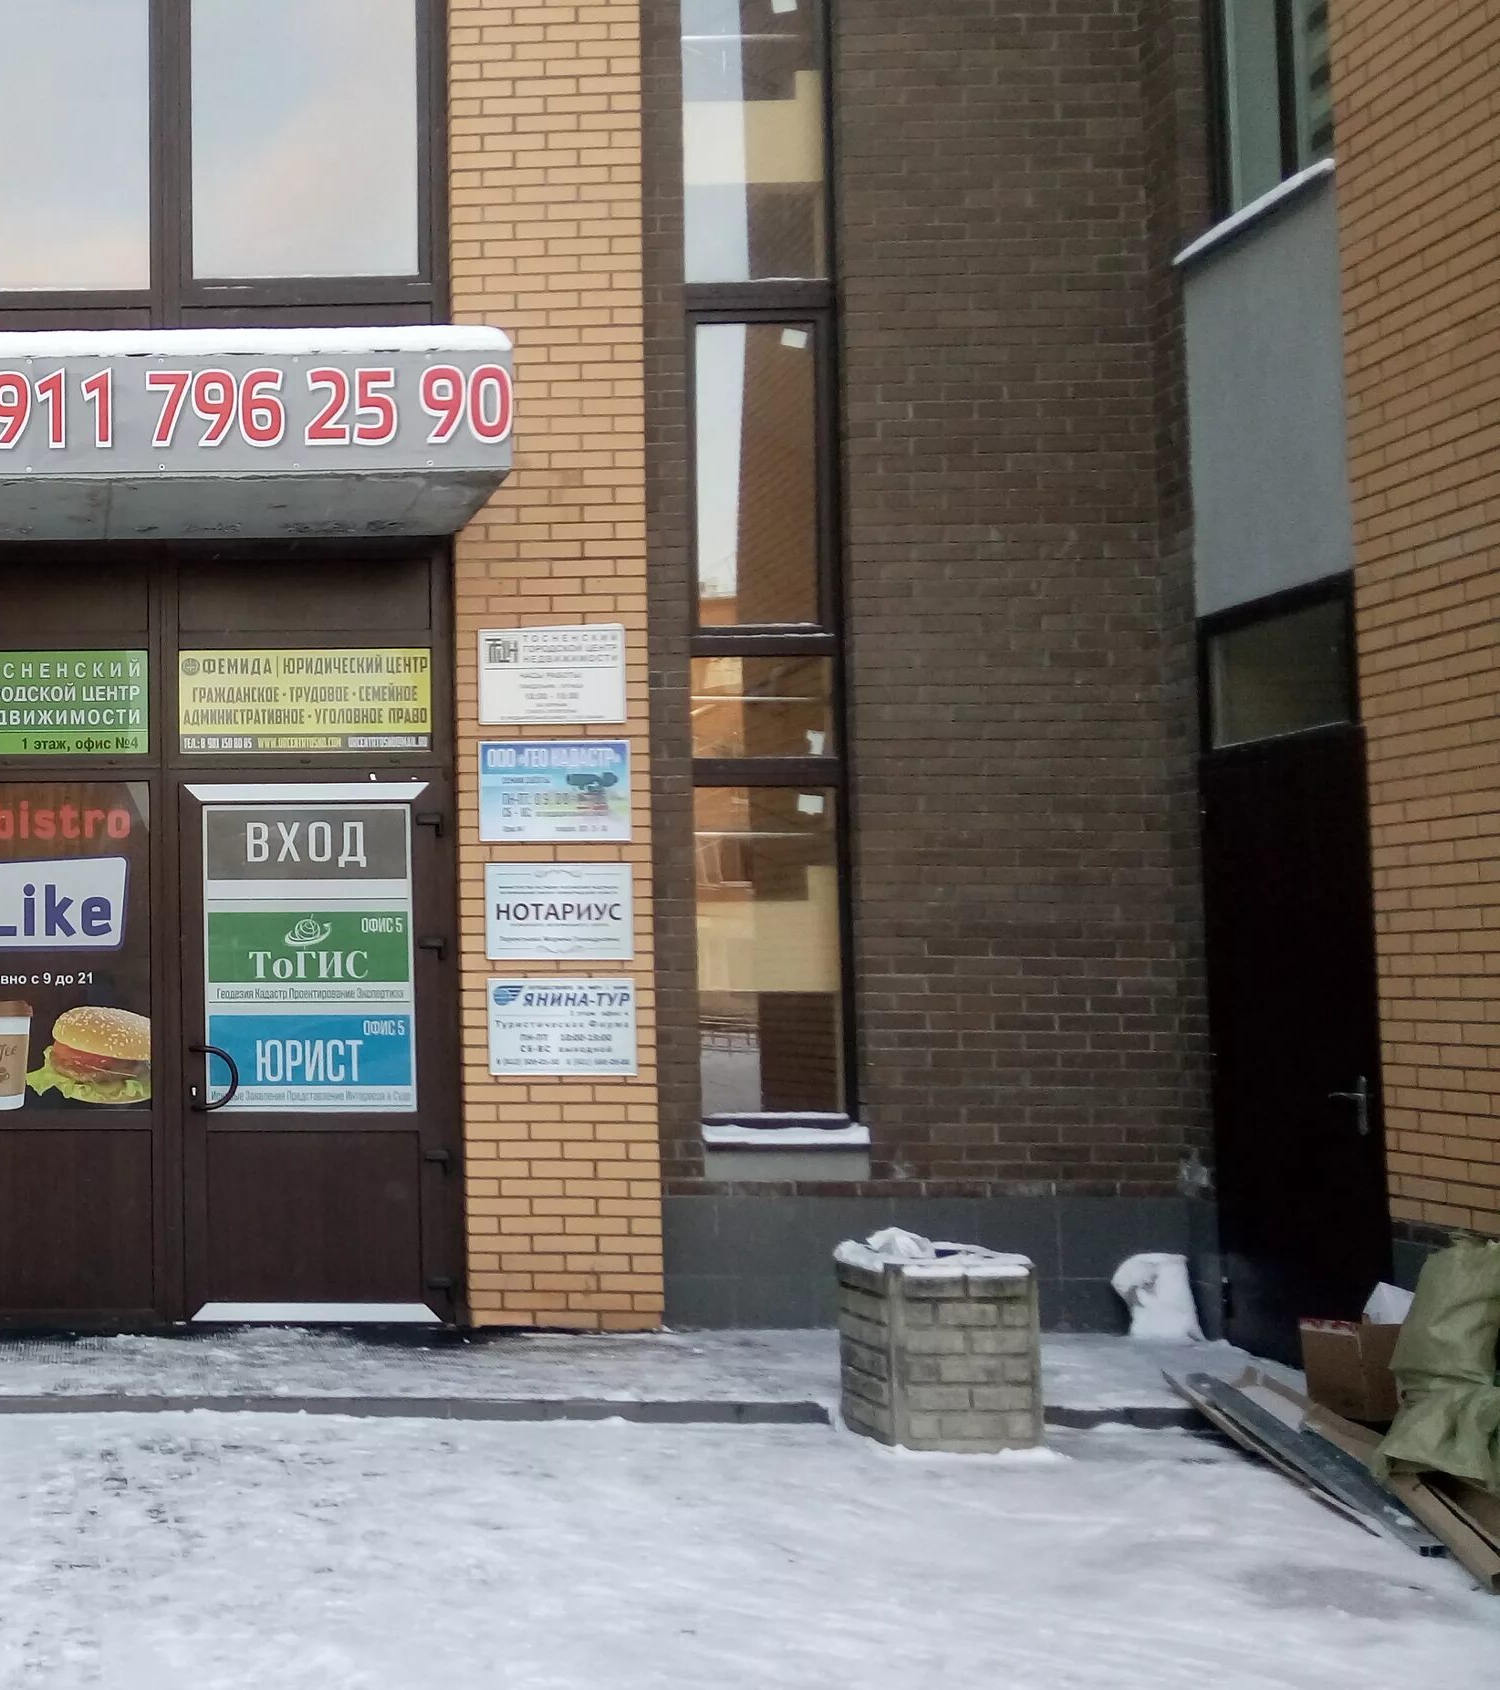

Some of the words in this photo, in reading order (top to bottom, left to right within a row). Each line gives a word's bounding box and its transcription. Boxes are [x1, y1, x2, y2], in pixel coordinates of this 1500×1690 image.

[145, 369, 284, 448] 796
[305, 367, 396, 447] 25
[419, 364, 512, 445] 90
[202, 657, 272, 675] ФЕМИДА
[283, 655, 384, 675] ЮРИДИЧЕСКИЙ
[386, 657, 427, 674] ЦЕНТР
[82, 686, 140, 703] ЦЕНТР
[193, 687, 279, 703] ГРАЖДАНСКОЕ
[289, 686, 348, 702] ТРУДОВОЕ
[359, 683, 417, 701] СЕМЕЙНОЕ
[184, 709, 304, 725] АДМИНИСТРАТИВНОЕ
[316, 708, 383, 724] УГОЛОВНОЕ
[389, 708, 427, 723] ПРАВО
[22, 737, 27, 749] 1
[34, 739, 70, 752] этаж,
[76, 737, 111, 752] офис
[246, 821, 367, 867] ВХОД
[496, 903, 622, 920] НОТАРИУС
[361, 918, 393, 933] ОФИС
[396, 918, 403, 933] 5
[249, 951, 368, 979] ТоГИС
[31, 975, 39, 984] с
[43, 973, 51, 984] 9
[55, 974, 74, 986] до
[78, 972, 93, 984] 21
[216, 988, 253, 999] Геодезия
[255, 988, 287, 999] Кадастр
[288, 988, 355, 999] Проектирование
[523, 993, 630, 1006] ЯНИНА-ТУР
[363, 1020, 395, 1036] ОФИС
[398, 1020, 404, 1035] 5
[256, 1039, 363, 1082] ЮРИСТ
